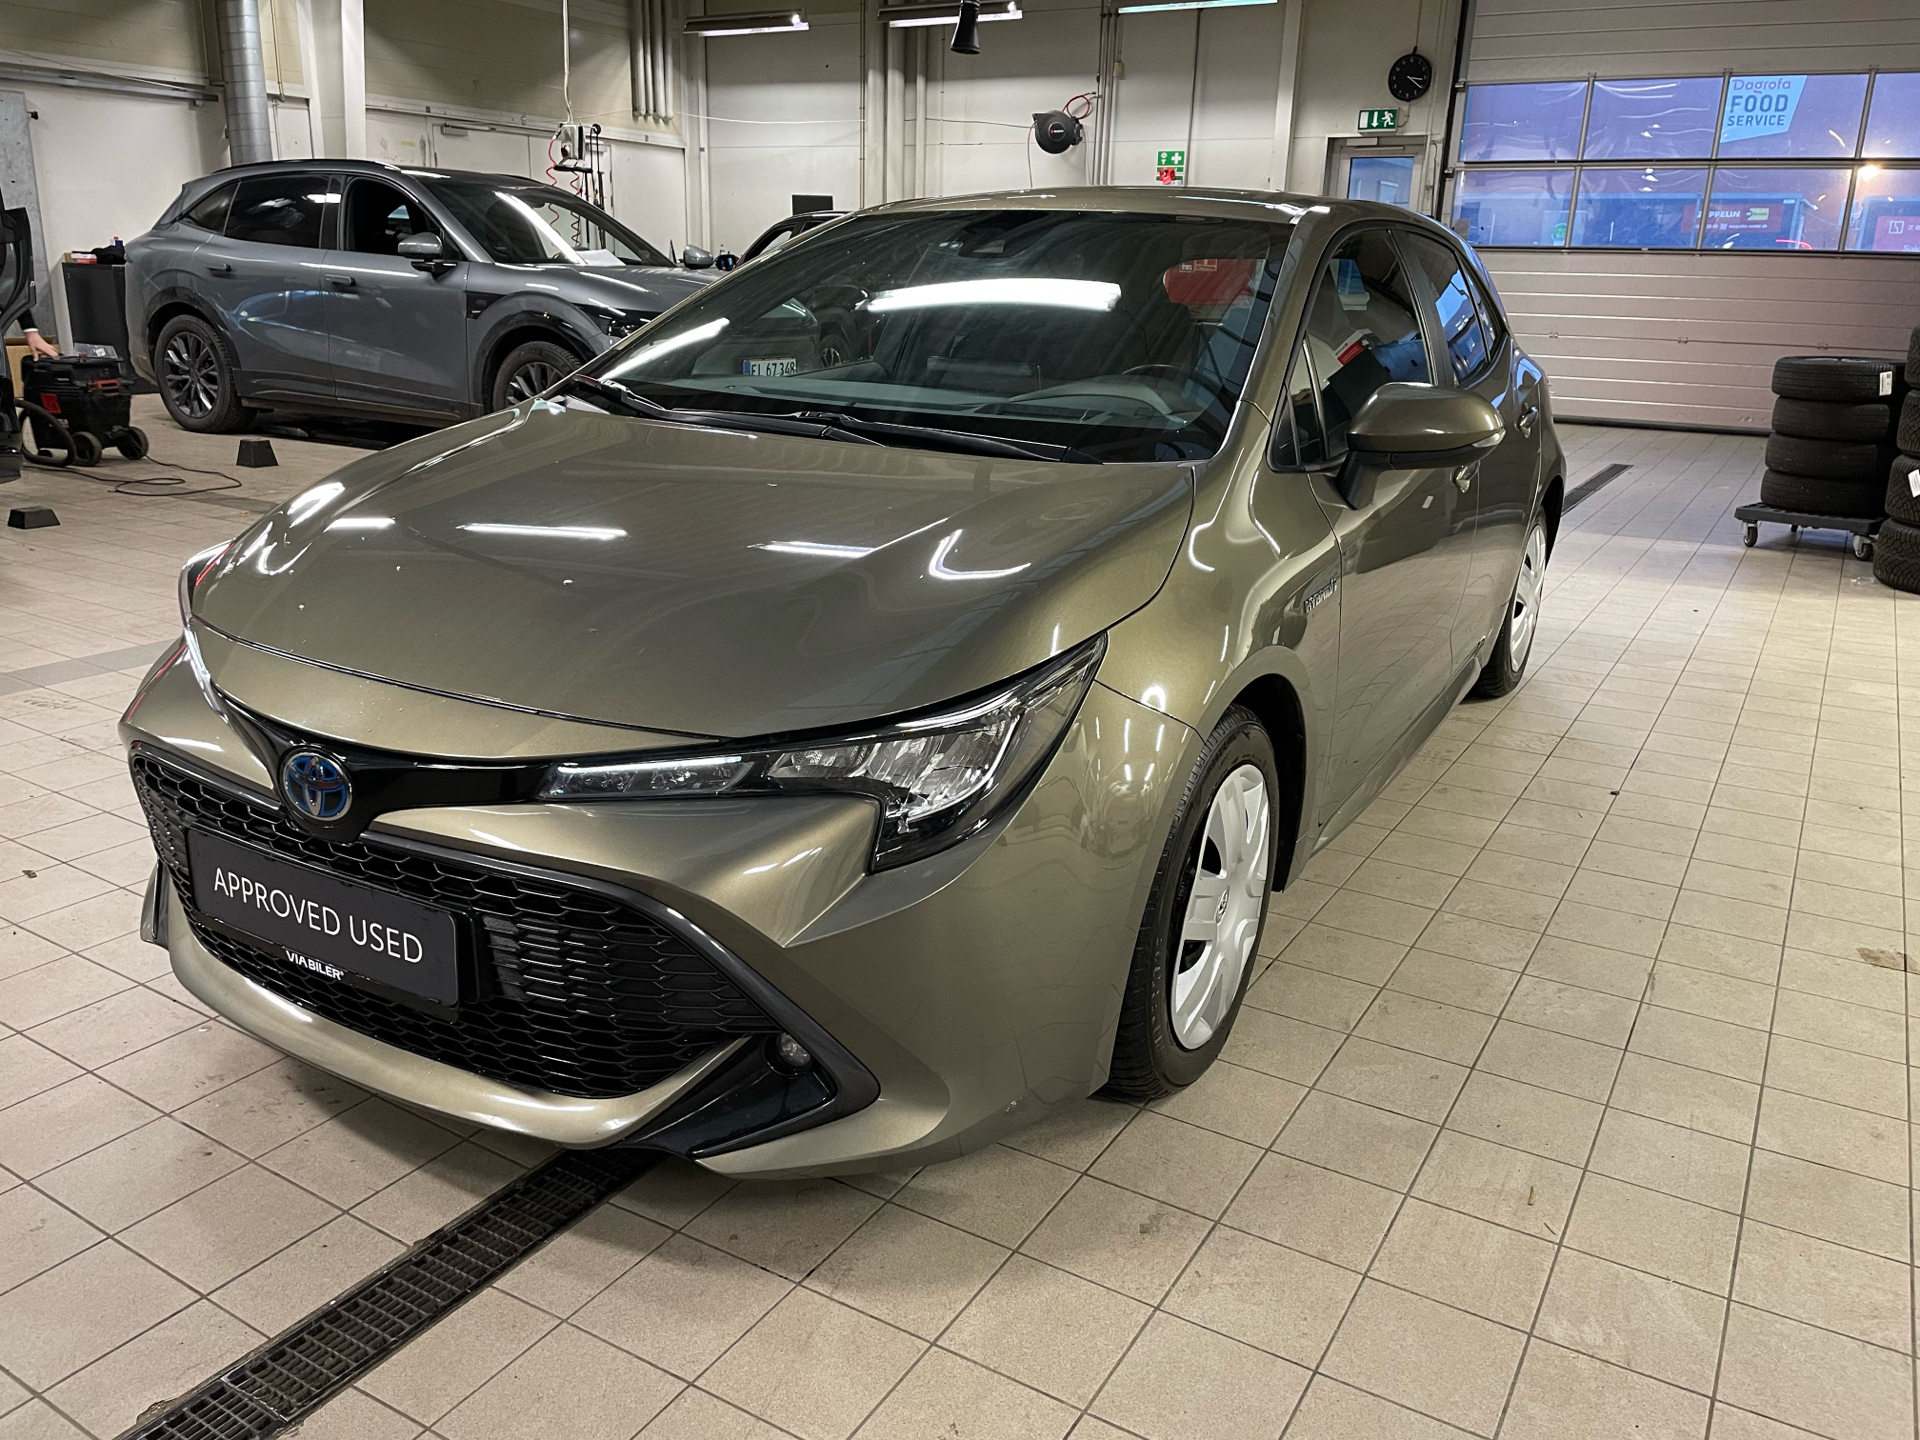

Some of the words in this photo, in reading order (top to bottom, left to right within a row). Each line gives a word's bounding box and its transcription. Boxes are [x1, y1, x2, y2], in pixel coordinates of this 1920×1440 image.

[1732, 78, 1791, 94] Dagrofa
[1730, 94, 1789, 113] FOOD
[1727, 115, 1786, 127] SERVICE
[214, 867, 341, 936] APPROVED
[349, 914, 423, 963] USED
